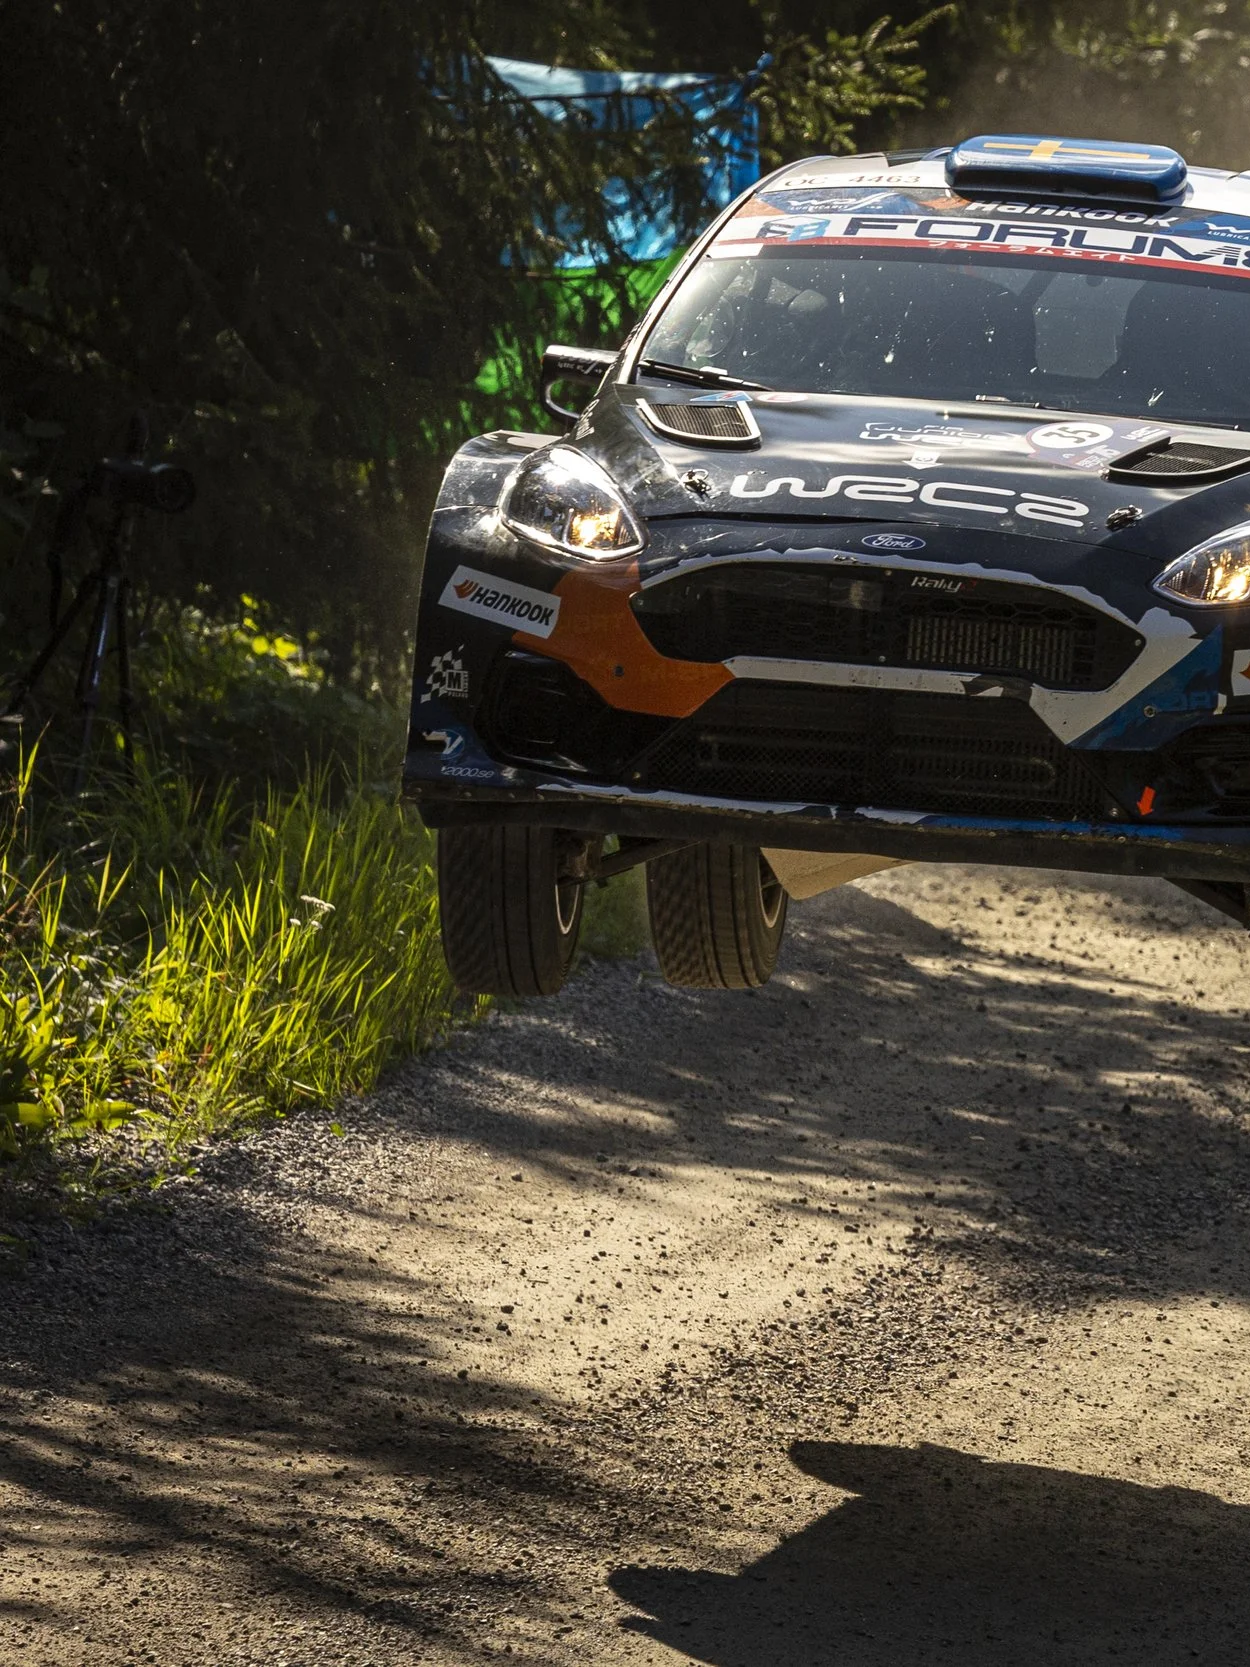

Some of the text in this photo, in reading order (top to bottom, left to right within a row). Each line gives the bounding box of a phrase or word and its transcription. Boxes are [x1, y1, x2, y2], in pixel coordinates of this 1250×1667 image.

[848, 174, 921, 184] 4463
[928, 239, 1136, 263] フォーラムエイト
[1041, 426, 1100, 445] 35
[729, 474, 1090, 528] WRC2
[871, 533, 916, 549] Ford
[470, 585, 556, 626] Hankook
[441, 766, 495, 779] 2000.se
